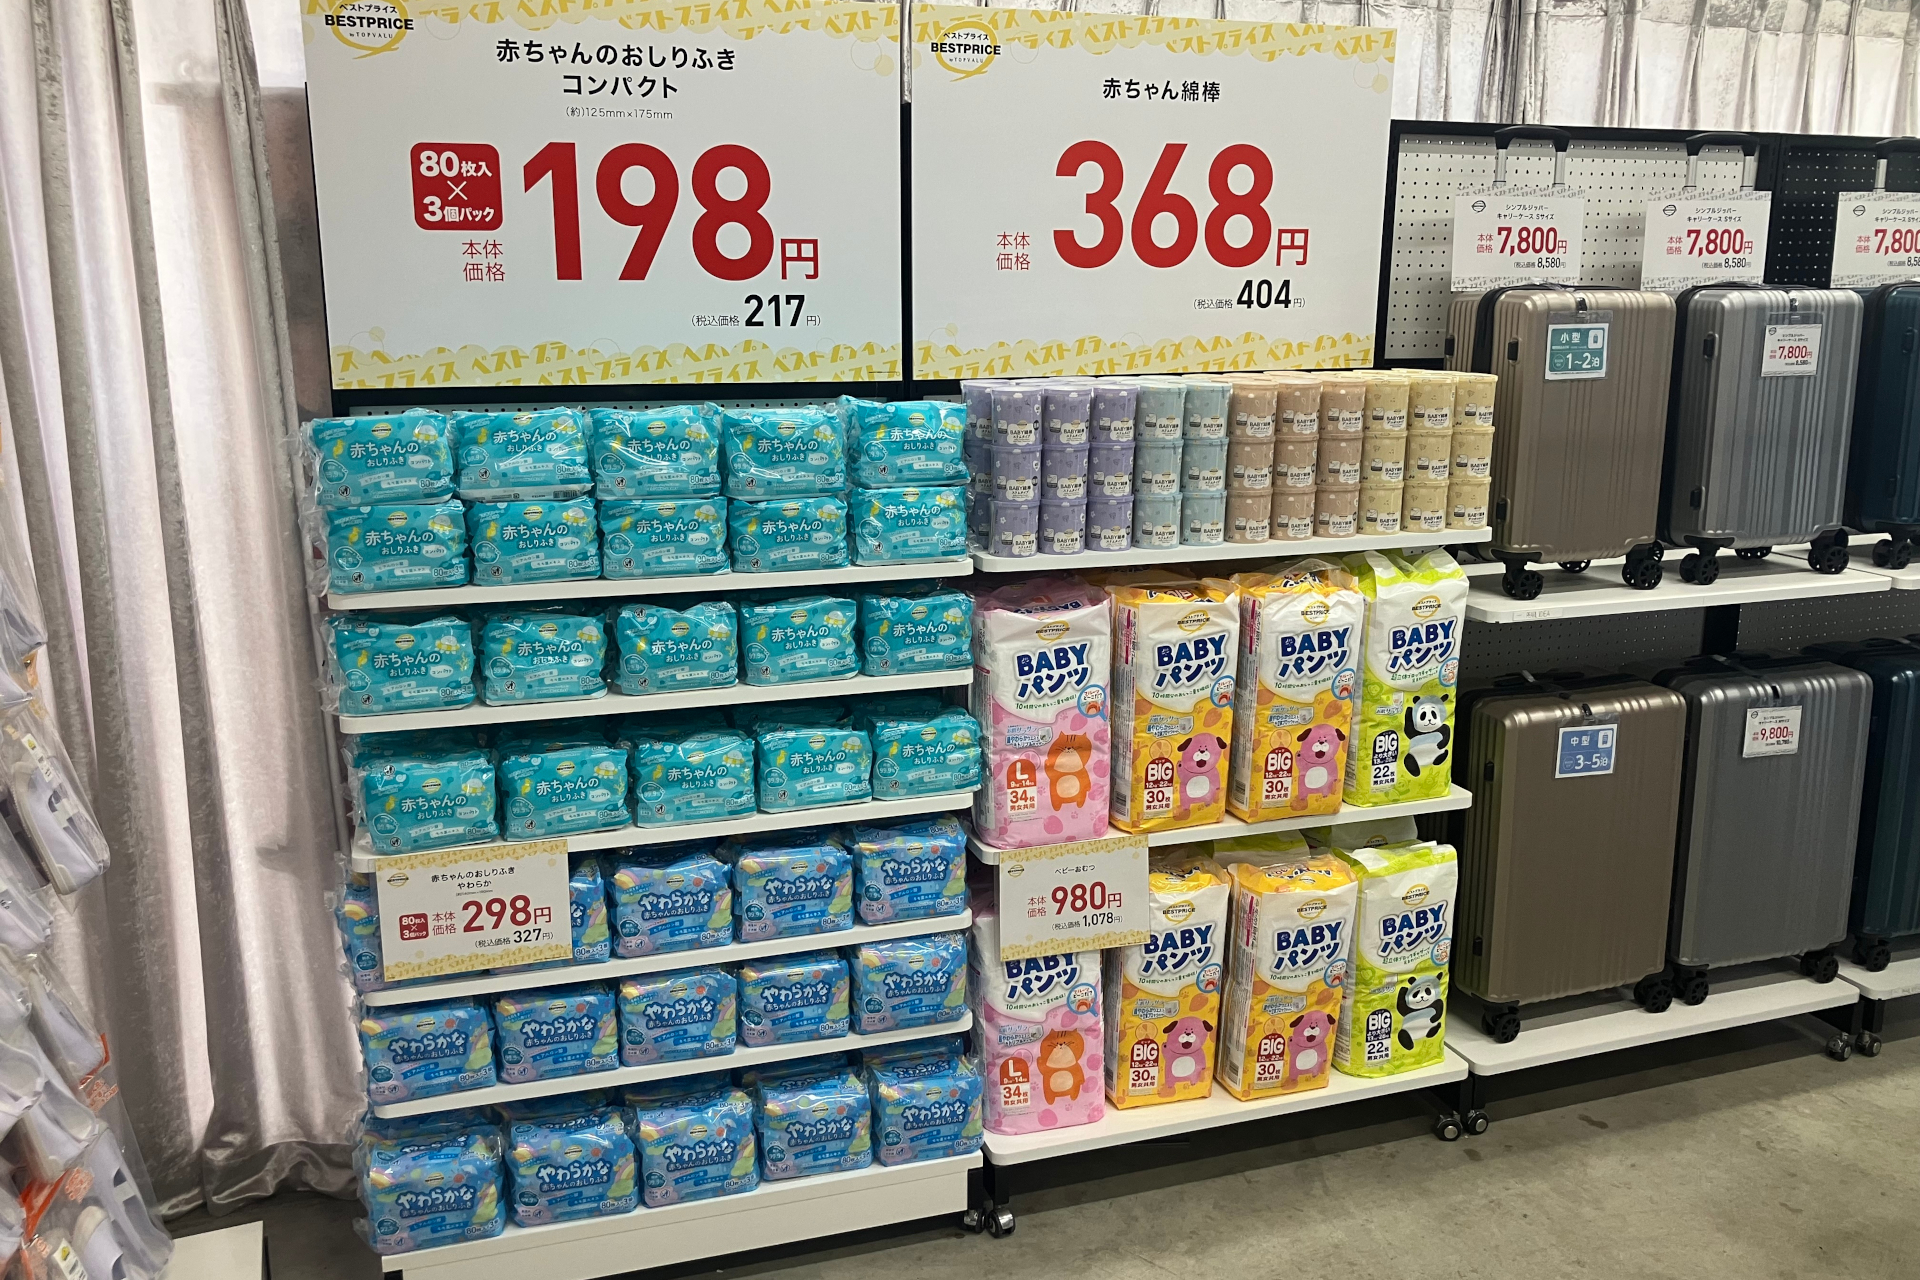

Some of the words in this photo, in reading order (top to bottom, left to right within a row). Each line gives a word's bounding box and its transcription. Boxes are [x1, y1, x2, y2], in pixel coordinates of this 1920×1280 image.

[339, 3, 397, 14] ベストプライス
[324, 14, 414, 31] BESTPRICE
[356, 31, 393, 39] TOPVALU
[943, 32, 990, 41] ベストプライス
[496, 38, 736, 72] 赤ちゃんのおしりふき
[930, 42, 1002, 56] BESTPRICE
[562, 74, 679, 99] コンパクト
[1102, 77, 1221, 103] 赤ちゃん綿棒
[565, 105, 674, 120] (約)125mm×175mm
[418, 150, 493, 179] 80枚入
[422, 196, 495, 224] 3個パック
[522, 141, 820, 282] 198円
[1052, 139, 1309, 269] 368円
[996, 232, 1031, 250] 本体
[1477, 233, 1494, 242] 本体
[1497, 226, 1568, 257] 7,800円
[1667, 236, 1683, 245] 本体
[1686, 228, 1753, 258] 7,800円
[461, 239, 504, 259] 本体
[995, 252, 1031, 271] 価格
[462, 261, 506, 283] 価格
[1560, 332, 1581, 344] 小型
[493, 428, 557, 445] 赤ちゃんの
[890, 427, 946, 442] 赤ちゃんの
[350, 441, 419, 459] 赤ちゃんの
[757, 438, 818, 453] 赤ちゃんの
[367, 456, 405, 468] おしりふき
[771, 452, 806, 463] おしりふき
[884, 503, 941, 518] 赤ちゃんの
[502, 523, 568, 541] 赤ちゃんの
[636, 519, 699, 535] 赤ちゃんの
[762, 519, 822, 534] 赤ちゃんの
[365, 529, 434, 547] 赤ちゃんの
[518, 538, 555, 549] おしりふき
[776, 532, 811, 543] おしりふき
[381, 544, 419, 556] おしりふき
[772, 625, 829, 642] 赤ちゃんの
[893, 621, 948, 637] 赤ちゃんの
[1392, 619, 1456, 651] BABY
[518, 640, 582, 657] 赤ちゃんの
[785, 639, 817, 650] おしりふき
[1156, 633, 1227, 667] BABY
[1280, 626, 1351, 658] BABY
[374, 651, 441, 669] 赤ちゃんの
[1016, 643, 1089, 677] BABY
[1278, 648, 1348, 679] パンツ
[1390, 641, 1453, 673] パンツ
[389, 666, 427, 677] おしりふき
[1155, 656, 1226, 688] パンツ
[1017, 667, 1089, 698] パンツ
[1375, 735, 1398, 754] BIG
[1570, 735, 1590, 746] 中型
[790, 750, 846, 768] 赤ちゃんの
[902, 742, 955, 758] 赤ちゃんの
[1016, 762, 1029, 780] L
[1267, 752, 1292, 772] BIG
[668, 765, 727, 781] 赤ちゃんの
[1147, 763, 1173, 782] BIG
[536, 776, 599, 796] 赤ちゃんの
[1265, 780, 1289, 794] 30枚
[401, 794, 467, 812] 赤ちゃんの
[551, 791, 587, 803] おしりふき
[1009, 789, 1036, 803] 34枚
[1146, 789, 1171, 804] 30枚
[431, 866, 515, 883] 赤ちゃんのおしりふき
[883, 858, 947, 876] やわらかな
[1054, 864, 1096, 875] ベビーおむつ
[457, 880, 492, 890] やわらか
[765, 876, 833, 896] やわらかな
[884, 871, 945, 886] 赤ちゃんのおしりふき
[640, 890, 710, 911] やわらかな
[766, 890, 832, 905] 赤ちゃんのおしりふき
[1027, 897, 1047, 907] 本体
[1051, 881, 1123, 916] 980円
[432, 911, 456, 923] 本体
[462, 894, 552, 933] 298円
[642, 905, 710, 920] 赤ちゃんのおしりふき
[1027, 908, 1047, 918] 価格
[1162, 905, 1196, 915] BESTPRICE
[1382, 904, 1445, 937] BABY
[432, 924, 457, 936] 価格
[1276, 920, 1343, 952] BABY
[1380, 923, 1444, 954] パンツ
[1143, 924, 1213, 956] BABY
[1142, 945, 1212, 974] パンツ
[1273, 941, 1340, 971] パンツ
[1005, 952, 1077, 980] BABY
[884, 972, 949, 990] やわらかな
[1007, 966, 1078, 999] パンツ
[762, 982, 830, 1003] やわらかな
[885, 986, 947, 1000] 赤ちゃんのおしりふき
[522, 1017, 595, 1037] やわらかな
[1368, 1012, 1392, 1031] BIG
[390, 1032, 467, 1053] やわらかな
[524, 1031, 593, 1048] 赤ちゃんのおしりふき
[1260, 1037, 1285, 1056] BIG
[1133, 1044, 1158, 1062] BIG
[1008, 1060, 1022, 1077] L
[1131, 1069, 1156, 1083] 30枚
[1003, 1085, 1028, 1099] 34枚
[903, 1102, 965, 1121] やわらかな
[537, 1163, 610, 1184] やわらかな
[541, 1176, 608, 1192] 赤ちゃんのおしりふき
[399, 1188, 476, 1209] やわらかな
